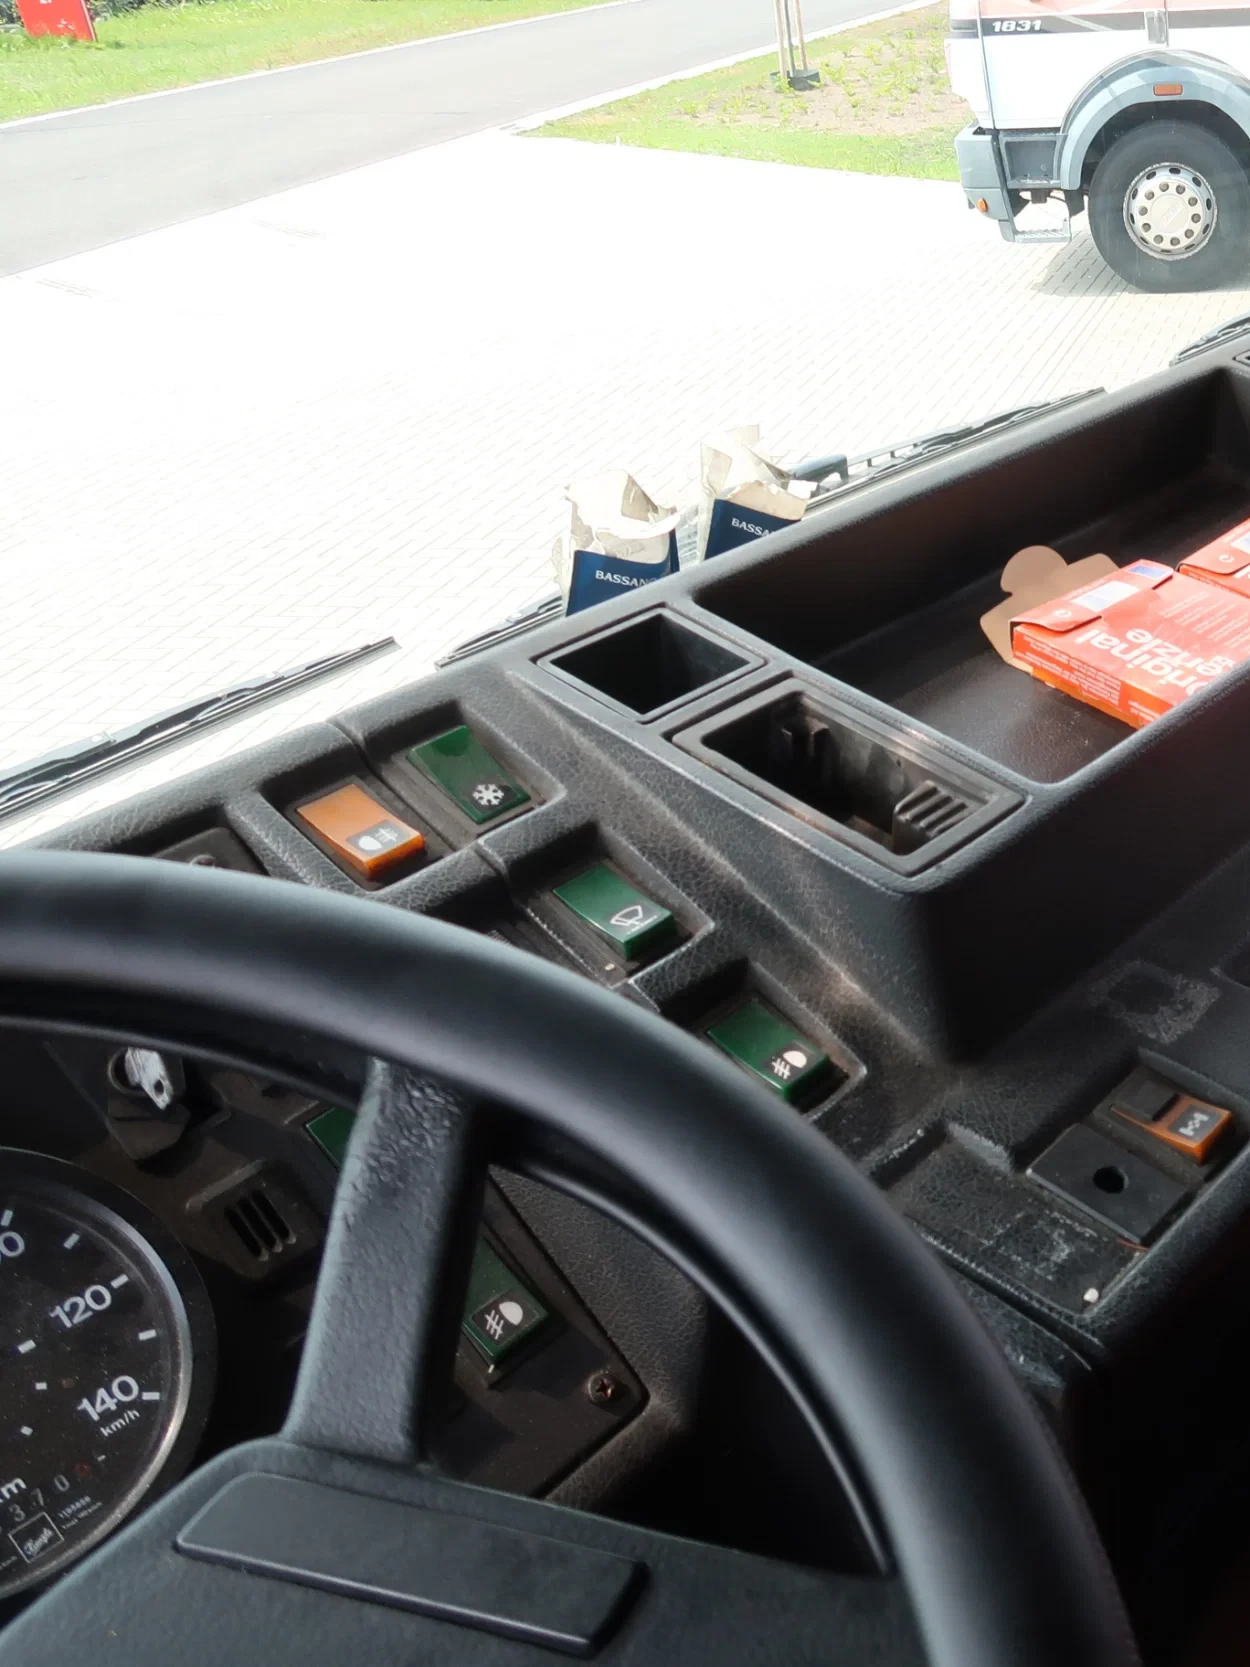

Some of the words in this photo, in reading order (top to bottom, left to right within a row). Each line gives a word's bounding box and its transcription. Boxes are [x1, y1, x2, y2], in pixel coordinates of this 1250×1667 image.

[992, 19, 1042, 32] 1831
[731, 517, 771, 537] BASSA
[1125, 628, 1224, 676] enzle
[49, 1284, 112, 1329] 120
[76, 1375, 140, 1422] 140
[100, 1409, 141, 1437] km/h
[0, 1477, 27, 1503] m
